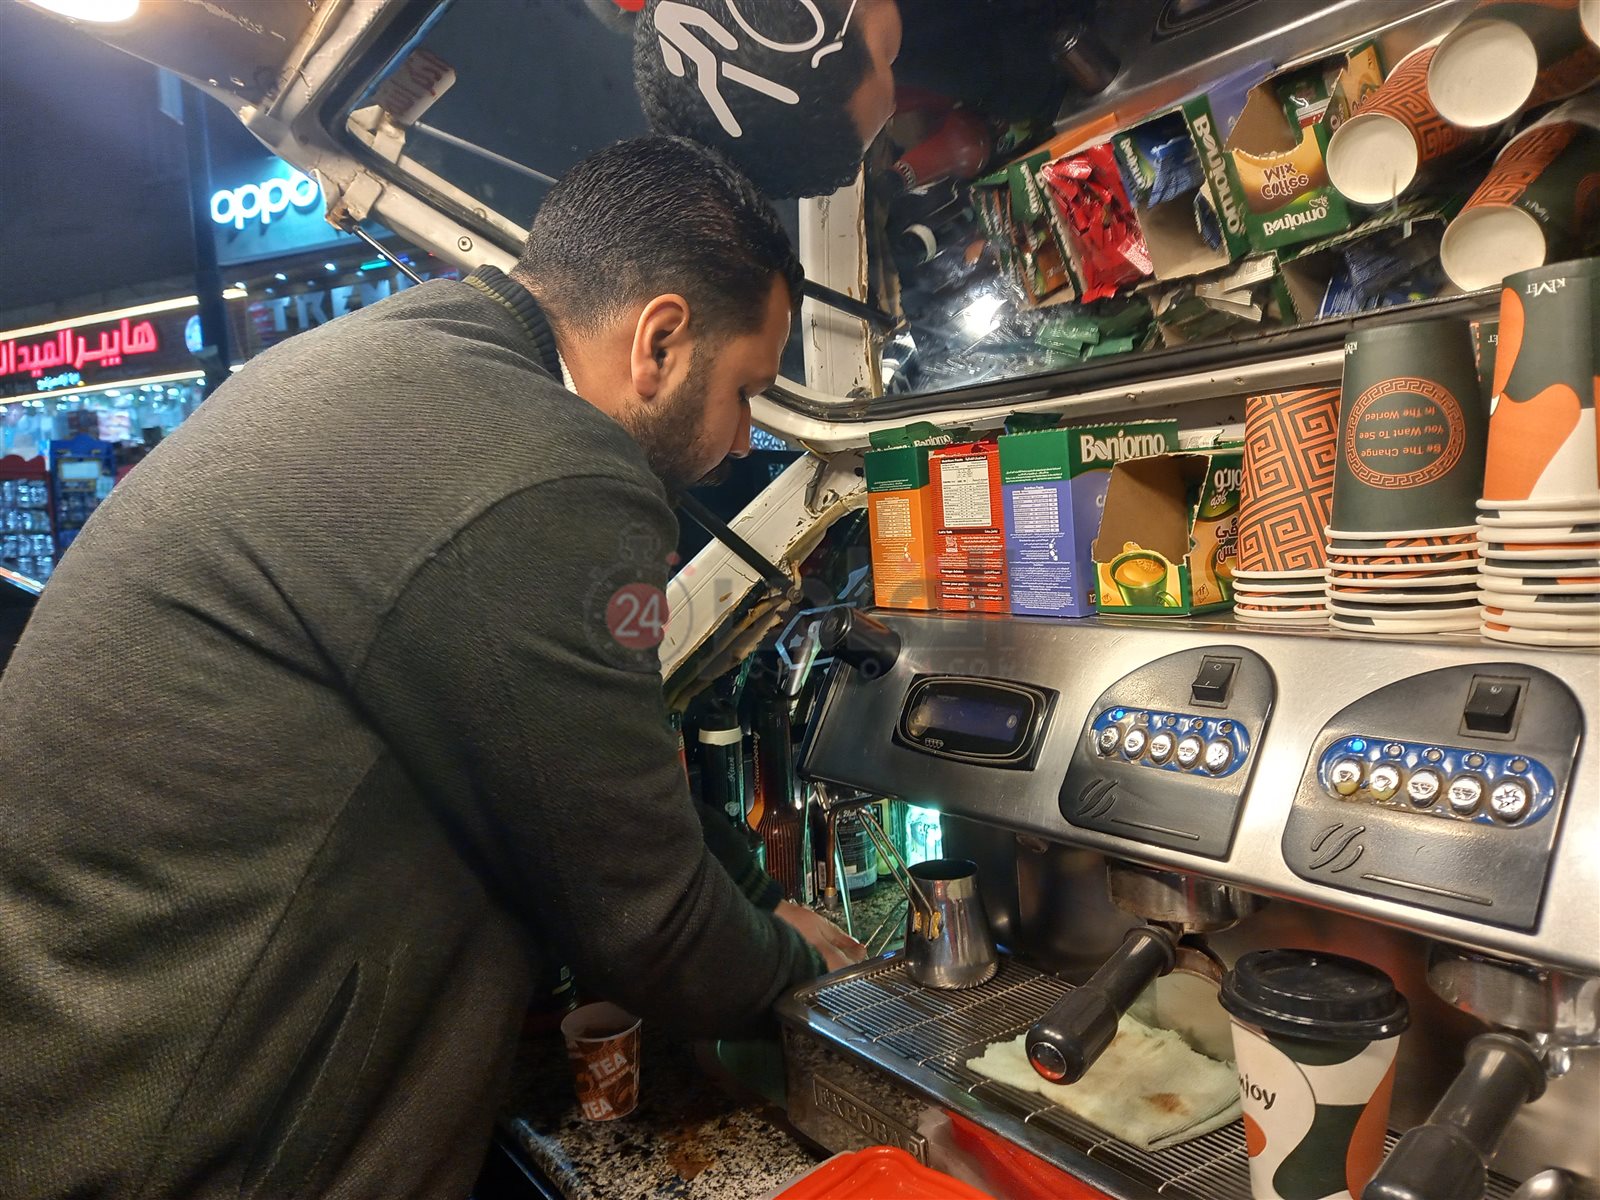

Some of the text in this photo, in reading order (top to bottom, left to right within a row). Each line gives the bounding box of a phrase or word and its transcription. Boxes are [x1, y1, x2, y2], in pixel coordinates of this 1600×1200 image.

[210, 168, 319, 230] oppo
[73, 317, 158, 370] هايبر
[1365, 410, 1400, 422] Worled
[1403, 408, 1422, 418] The
[1359, 424, 1444, 440] You Want To See
[1080, 429, 1167, 463] Bonjorno
[1360, 447, 1400, 457] Change
[1403, 446, 1424, 456] The
[588, 1050, 628, 1082] TEA
